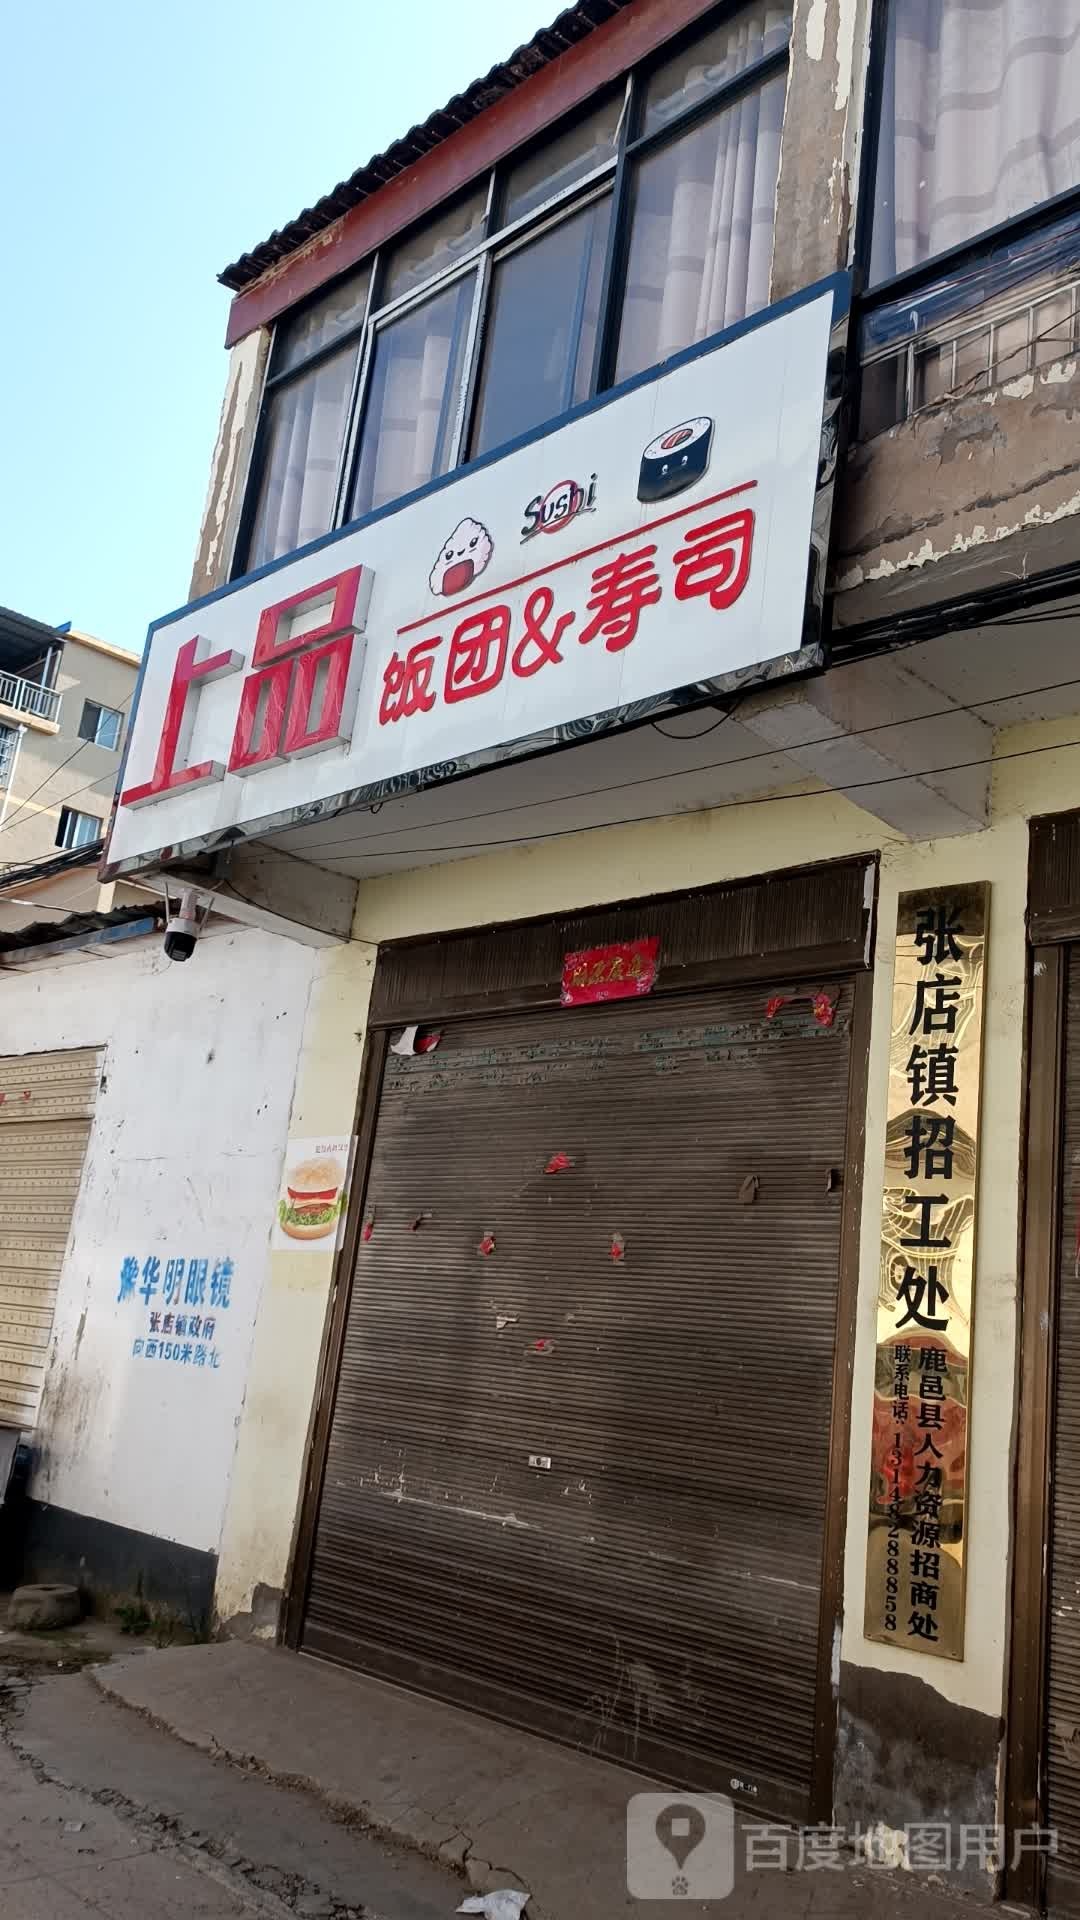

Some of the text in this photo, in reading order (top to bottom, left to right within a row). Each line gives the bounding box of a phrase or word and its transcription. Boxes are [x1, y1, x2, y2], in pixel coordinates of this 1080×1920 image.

[521, 473, 598, 535] Sushi
[121, 564, 373, 808] 上品
[379, 509, 756, 726] 饭团&寿司
[896, 906, 965, 1331] 张店镇招工处
[132, 1338, 221, 1368] 向西150米路北
[149, 1311, 216, 1340] 张店镇政府
[907, 1347, 948, 1642] 鹿邑县人力资源招商处
